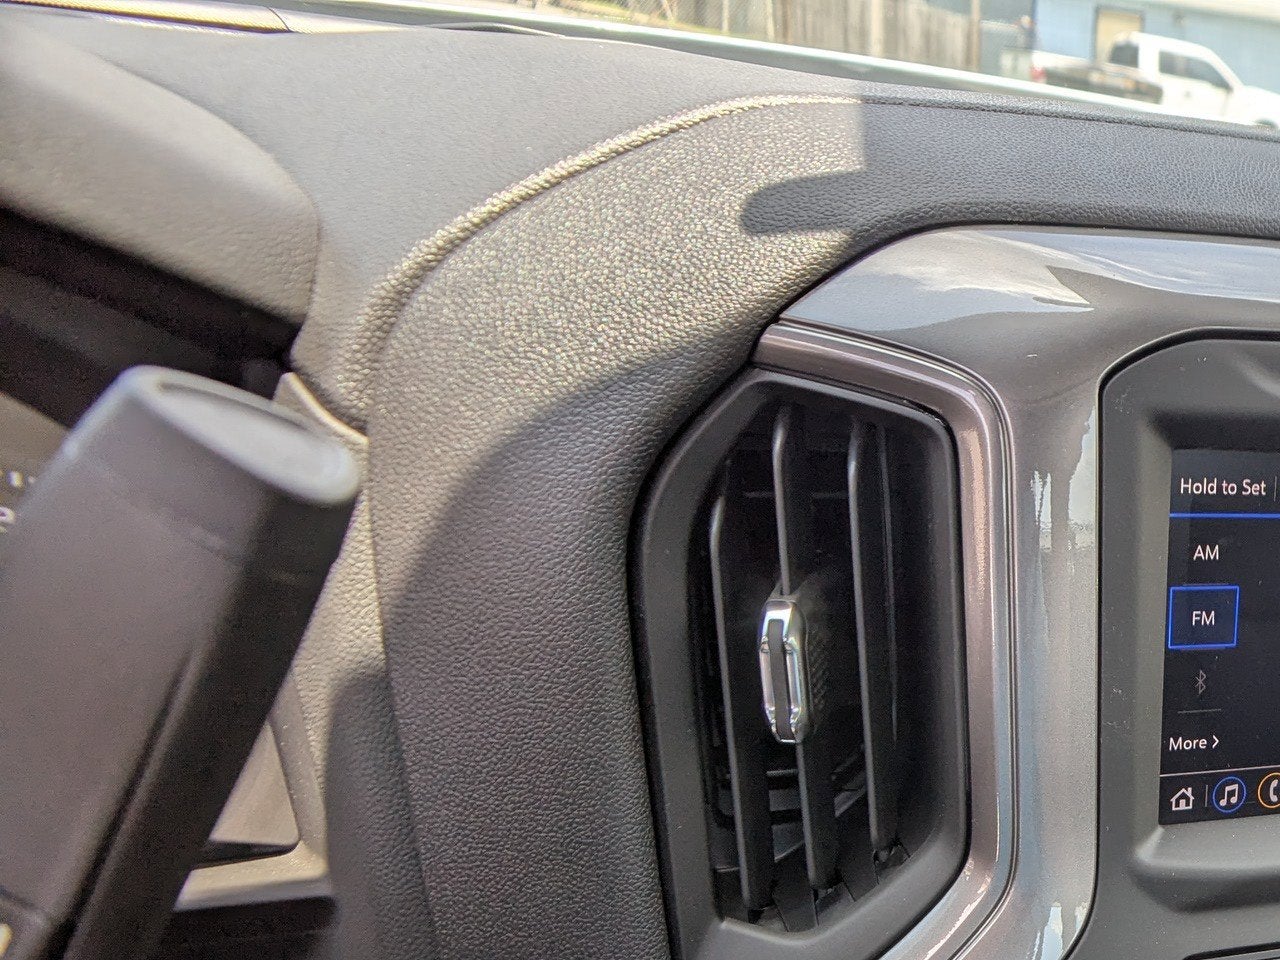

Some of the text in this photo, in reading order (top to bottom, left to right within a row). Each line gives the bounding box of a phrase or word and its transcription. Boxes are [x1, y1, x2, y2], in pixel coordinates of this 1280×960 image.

[1180, 477, 1266, 496] Hold to Set
[1193, 544, 1219, 560] AM
[1191, 611, 1215, 626] FM
[1168, 737, 1208, 751] More
